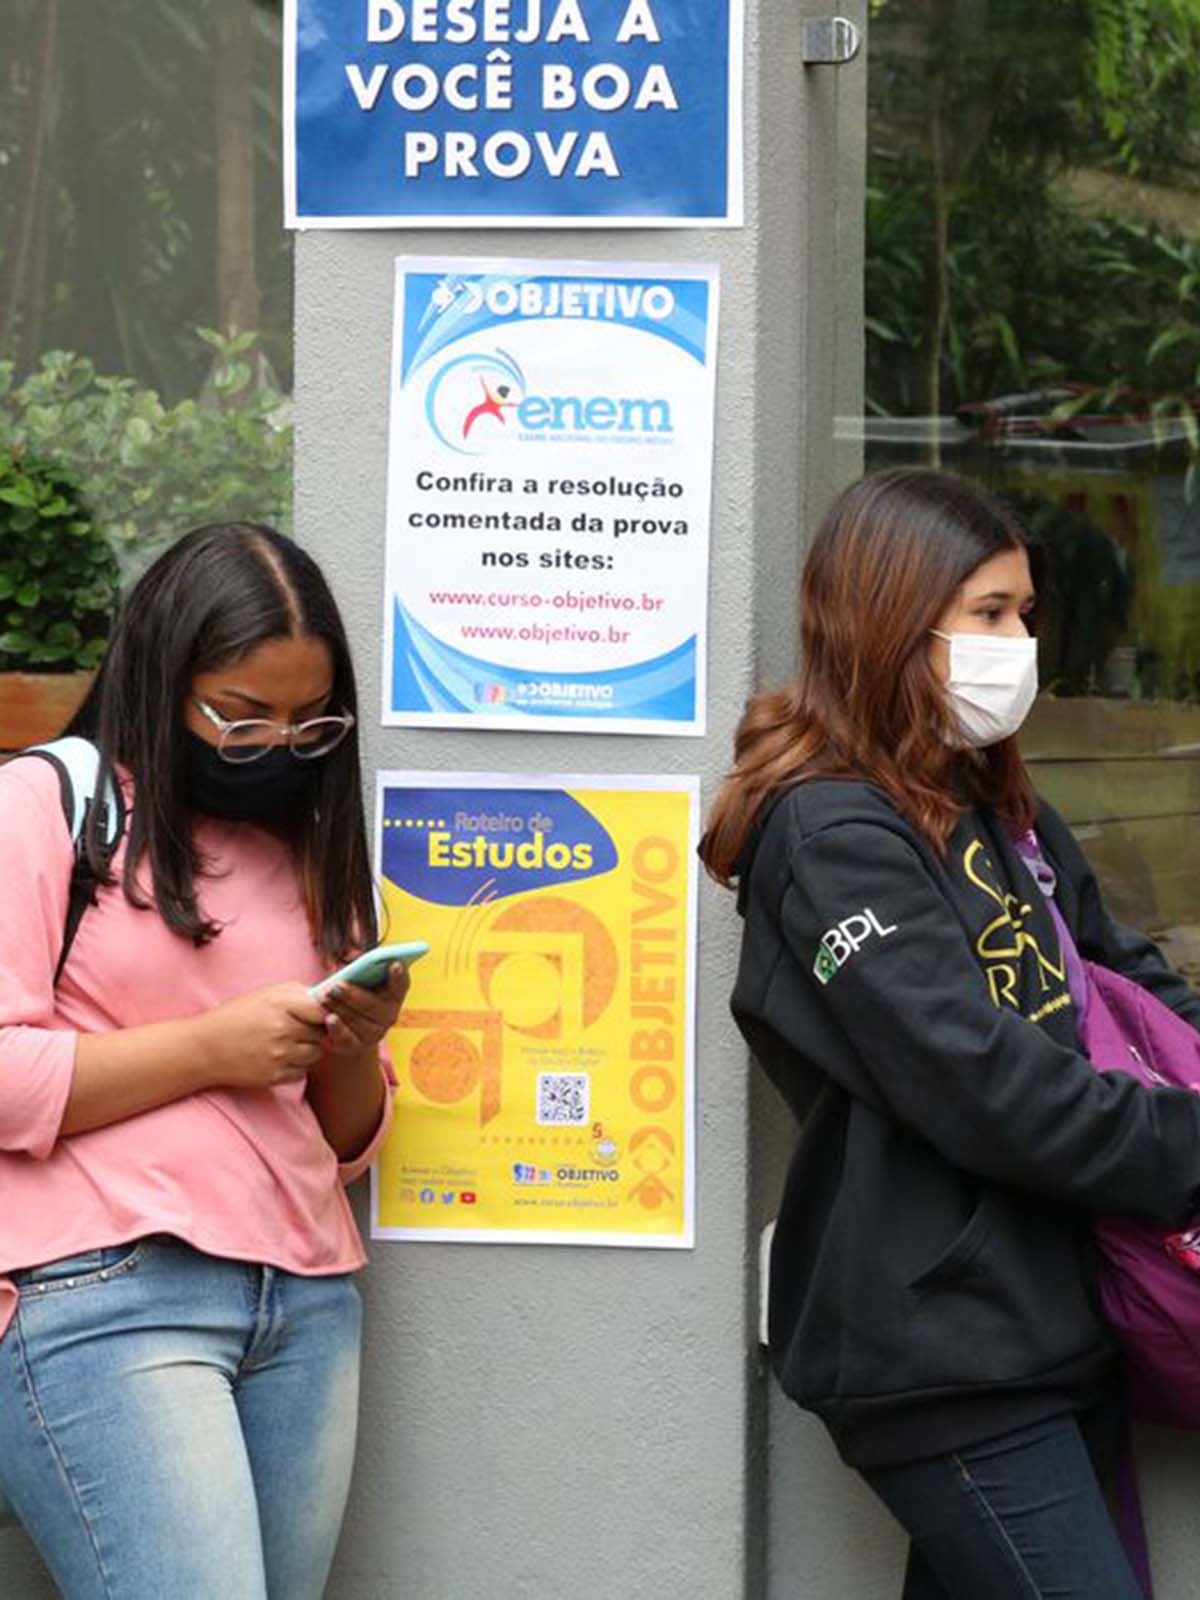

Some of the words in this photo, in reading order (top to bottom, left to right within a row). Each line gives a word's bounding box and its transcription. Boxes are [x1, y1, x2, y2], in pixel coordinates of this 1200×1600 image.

[366, 0, 590, 43] DESEJA
[616, 0, 662, 43] A
[345, 48, 513, 111] VOCÊ
[541, 64, 679, 111] BOA
[405, 131, 621, 178] PROVA
[485, 282, 676, 320] OBJETIVO
[517, 395, 674, 433] enem
[415, 471, 513, 495] Confira
[523, 479, 539, 495] a
[549, 475, 684, 501] resolução
[408, 511, 562, 533] comentada
[571, 512, 604, 534] da
[613, 517, 689, 539] prova
[481, 551, 530, 569] nos
[539, 549, 614, 571] sites:
[428, 589, 665, 613] www.curso-objetivo.br
[460, 625, 632, 645] www.objetivo.br
[455, 812, 524, 833] Roteiro
[526, 812, 553, 833] de
[427, 831, 594, 870] Estudos
[822, 906, 898, 967] BPL
[629, 835, 681, 1114] OBJETIVO
[556, 1168, 619, 1182] OBJETIVO
